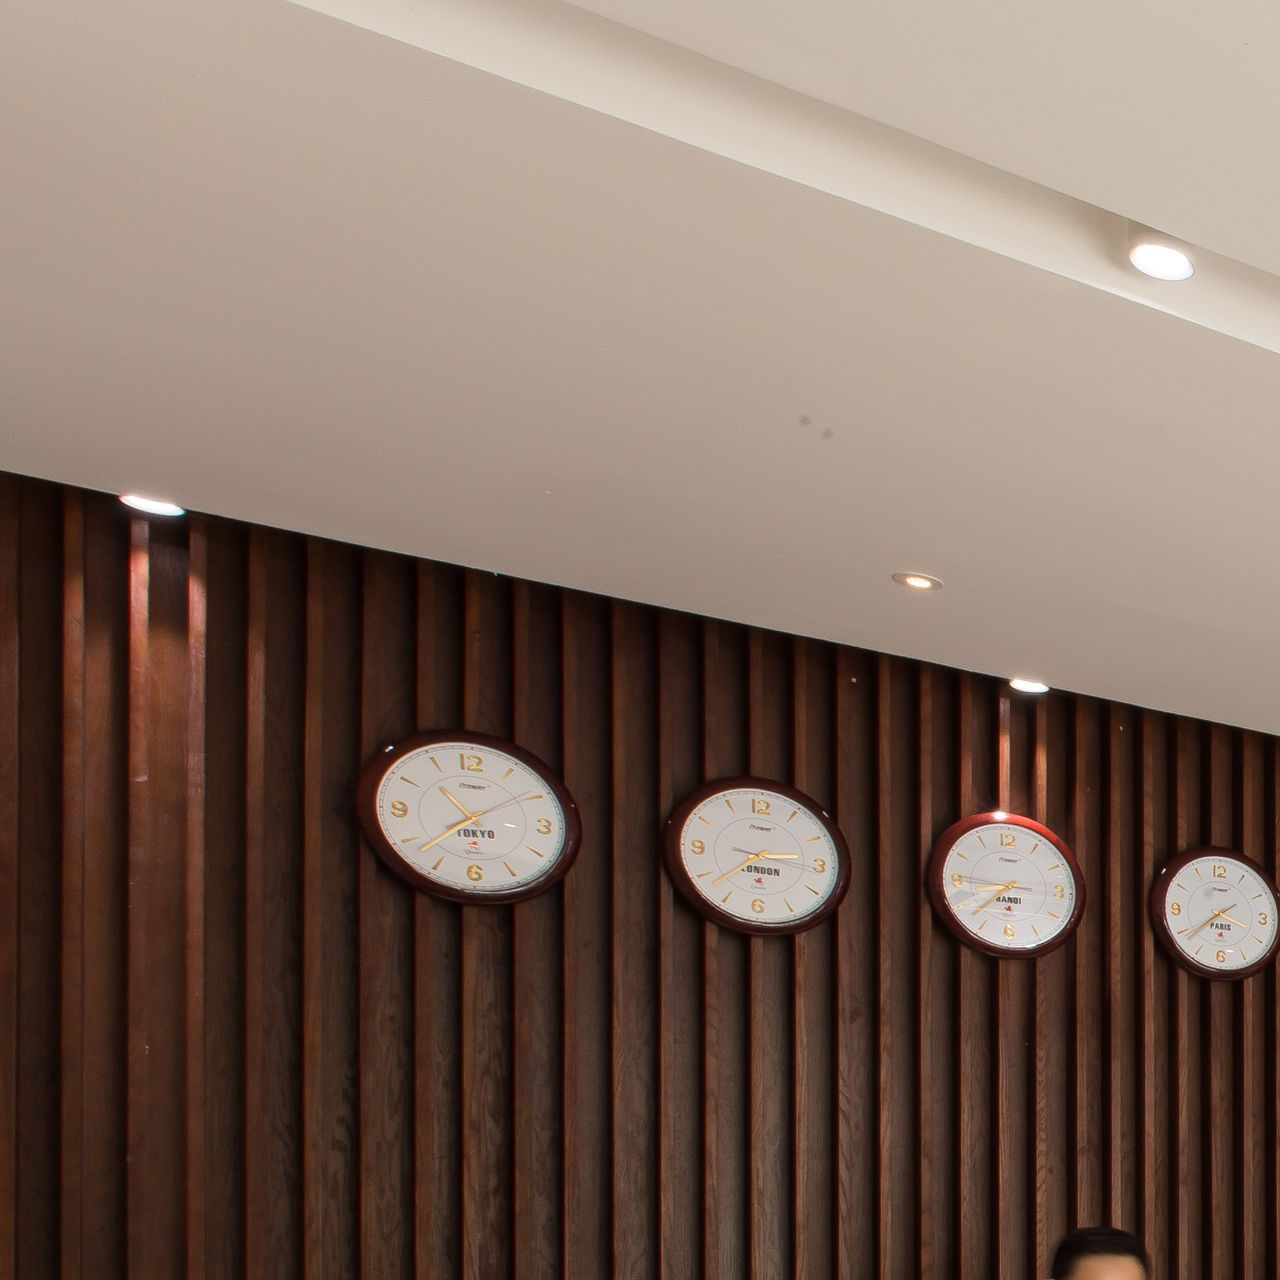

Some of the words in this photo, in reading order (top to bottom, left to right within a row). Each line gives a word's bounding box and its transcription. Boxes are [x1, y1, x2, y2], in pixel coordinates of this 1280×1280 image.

[460, 753, 484, 773] 12
[391, 800, 409, 818] 9
[751, 798, 771, 816] 12
[456, 828, 496, 840] TOKYO
[536, 817, 552, 835] 3
[690, 839, 706, 855] 9
[1000, 833, 1016, 849] 12
[467, 864, 484, 882] 6
[812, 858, 826, 874] 3
[1212, 865, 1227, 879] 12
[951, 872, 964, 888] 9
[1053, 885, 1065, 900] 3
[751, 898, 766, 914] 6
[1171, 902, 1182, 916] 9
[1210, 922, 1232, 931] PARIS
[1258, 912, 1268, 926] 3
[1003, 923, 1016, 940] 6
[1216, 950, 1226, 963] 6
